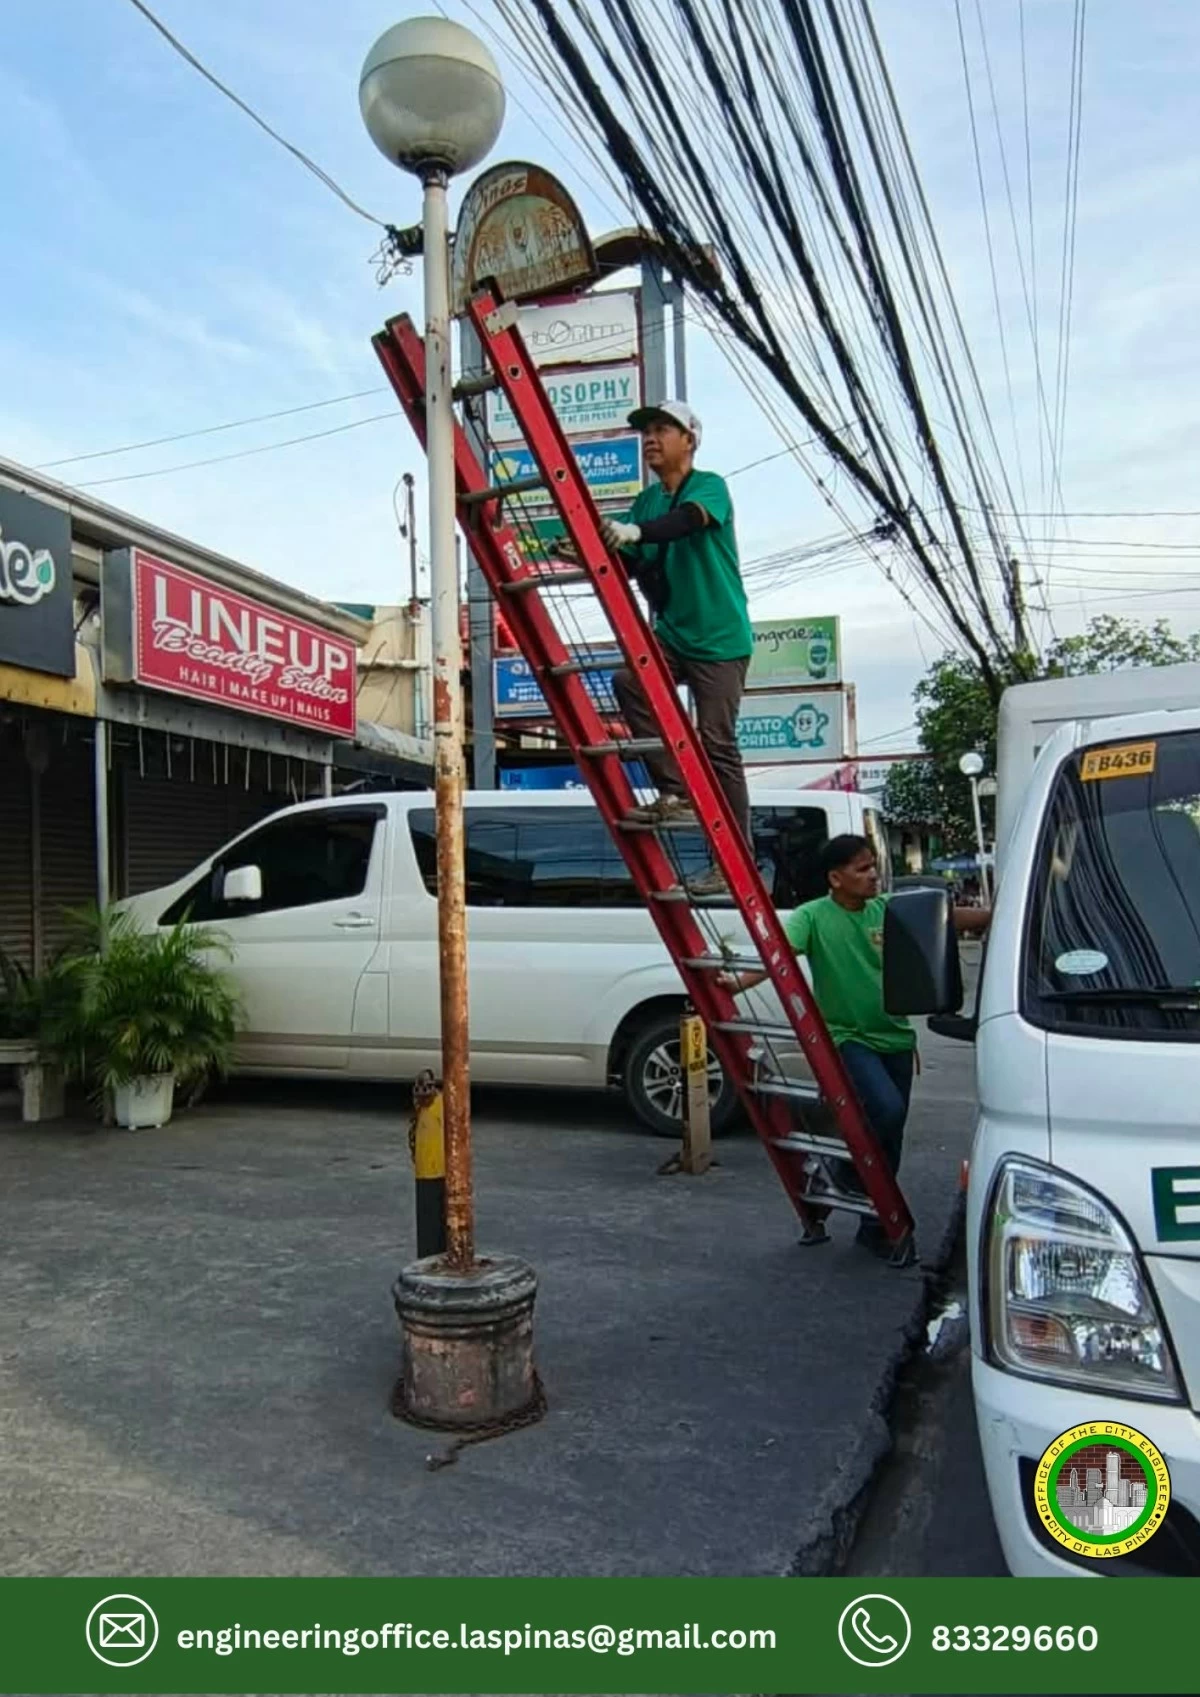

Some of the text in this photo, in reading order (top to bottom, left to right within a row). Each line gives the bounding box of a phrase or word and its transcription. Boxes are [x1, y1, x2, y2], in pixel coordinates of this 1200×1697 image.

[155, 575, 348, 681] LINEUP
[153, 620, 348, 704] Beauty Salon
[179, 666, 331, 721] HAIR MAKE UP NAILS
[736, 718, 782, 733] OTATO
[737, 732, 787, 747] ORNER
